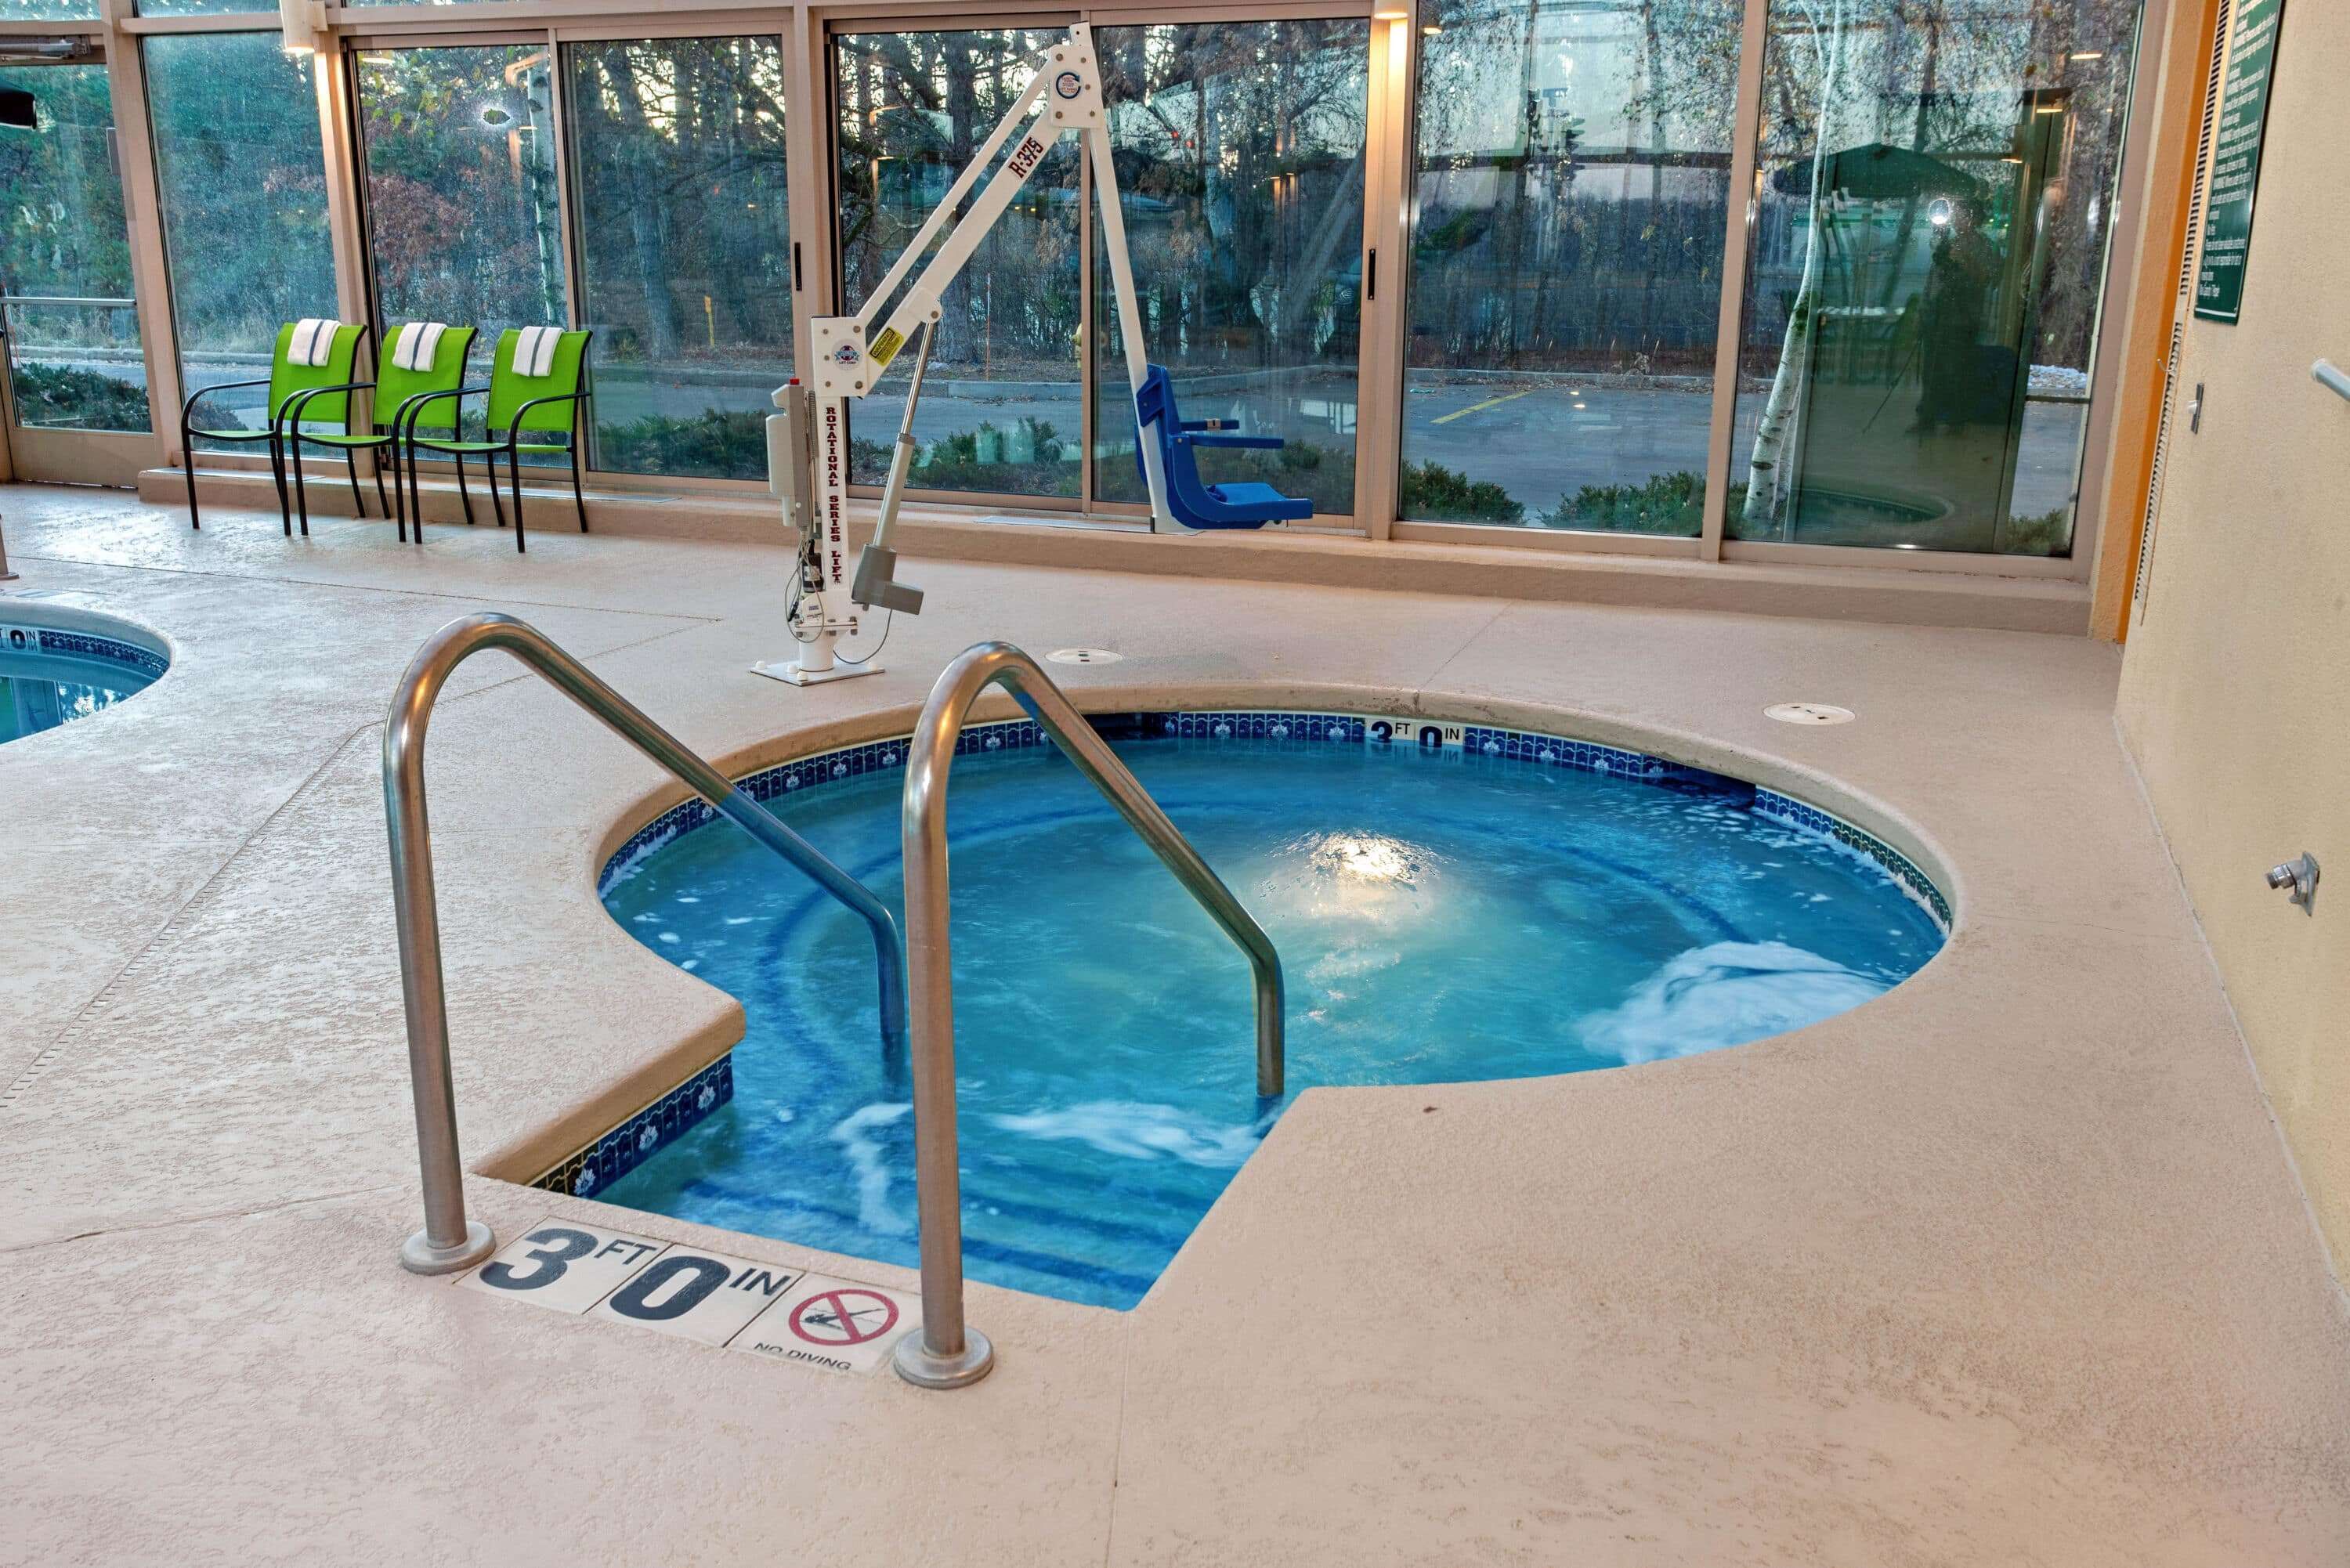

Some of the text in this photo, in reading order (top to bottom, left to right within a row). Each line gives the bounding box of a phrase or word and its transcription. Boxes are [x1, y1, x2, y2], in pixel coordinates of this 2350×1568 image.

[826, 406, 842, 581] ROTATIONAL SERIES LIFT
[1395, 722, 1411, 735] FT
[1445, 727, 1459, 740] IN
[479, 1227, 791, 1321] 3 FT 0 IN
[754, 1342, 852, 1371] NO DIVING
